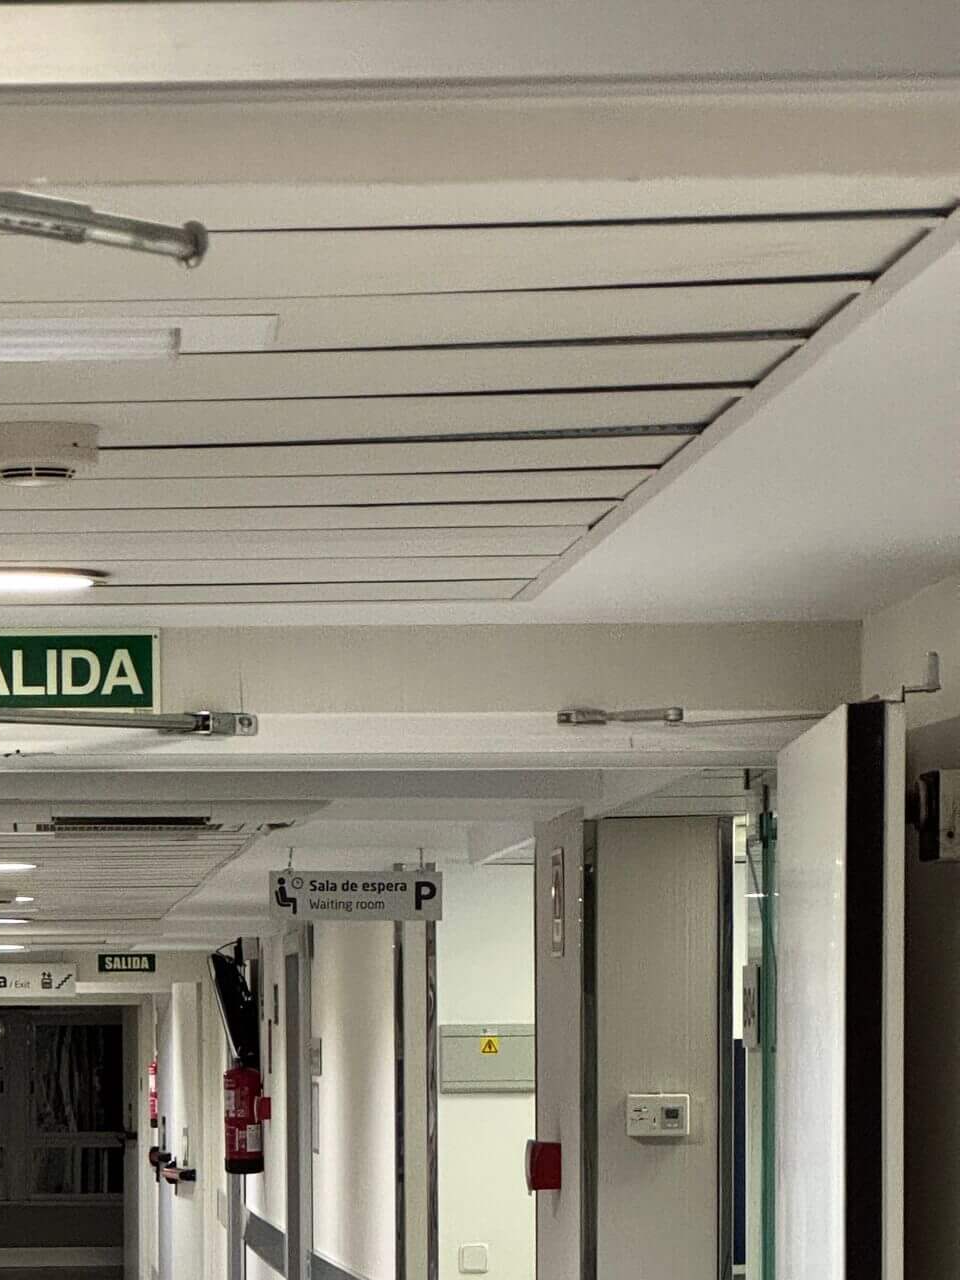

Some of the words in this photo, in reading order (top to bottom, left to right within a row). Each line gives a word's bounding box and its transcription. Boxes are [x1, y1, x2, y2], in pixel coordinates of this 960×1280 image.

[309, 880, 338, 892] Sala
[341, 880, 358, 892] de
[361, 882, 408, 894] espera
[414, 881, 437, 911] P
[309, 899, 353, 912] Waiting
[355, 900, 385, 910] room
[104, 956, 150, 970] SALIDA
